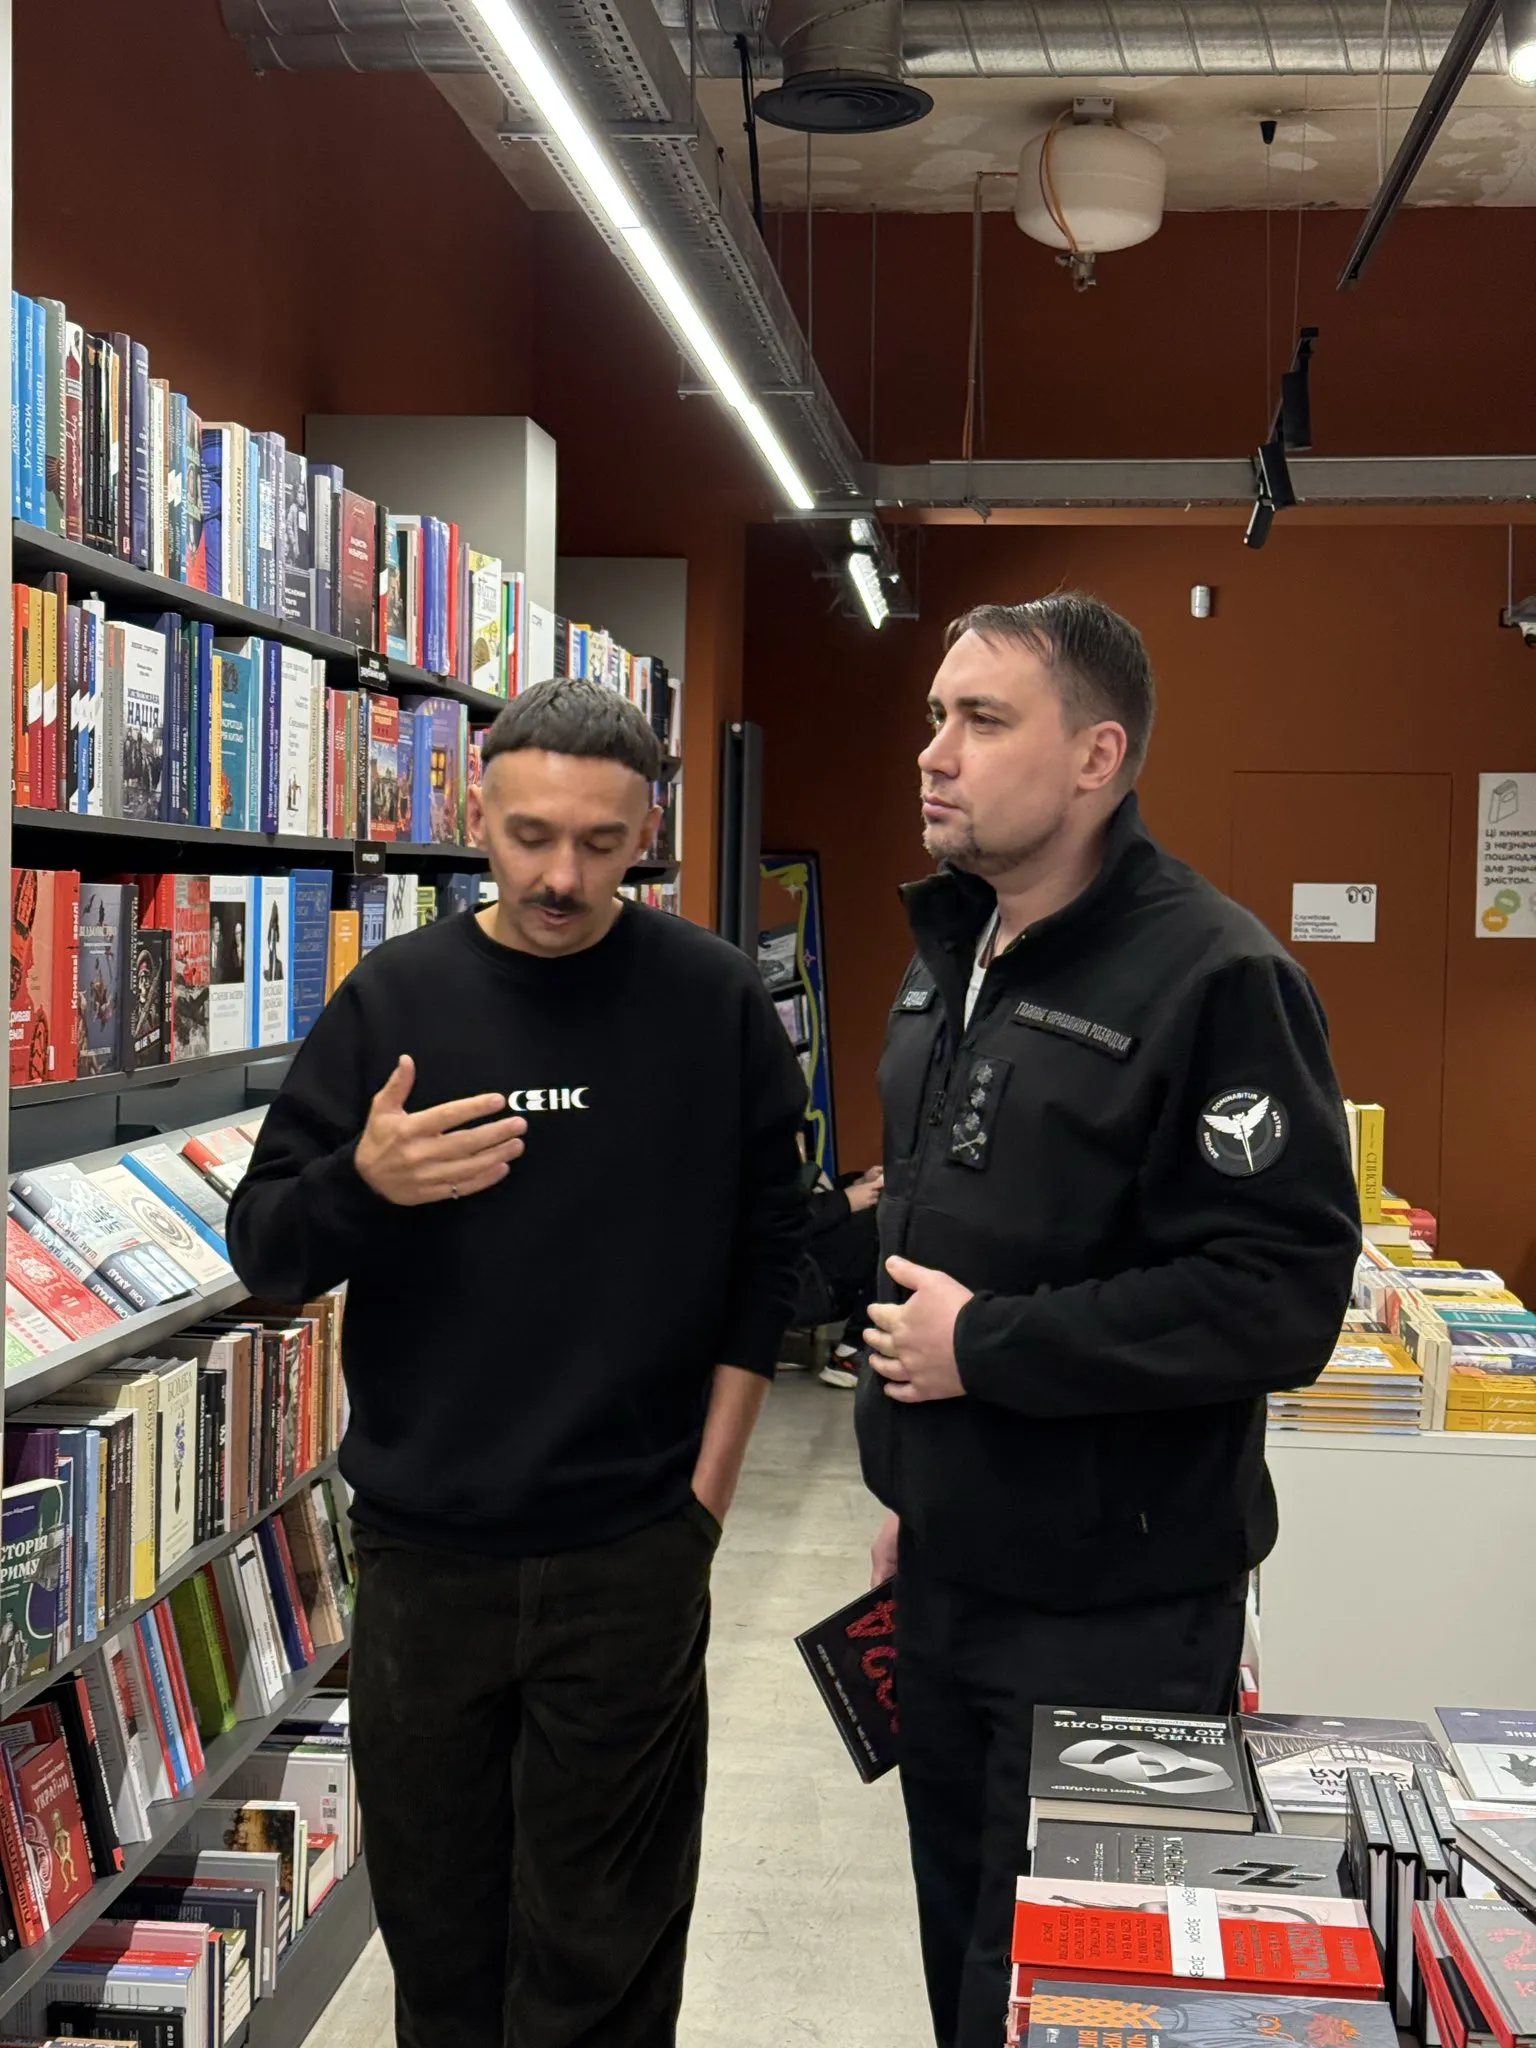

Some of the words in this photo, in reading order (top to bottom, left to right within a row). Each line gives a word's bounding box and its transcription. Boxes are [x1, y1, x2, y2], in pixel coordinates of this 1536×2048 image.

[23, 403, 32, 469] МОССАД
[127, 701, 161, 730] НАЦІЯ
[1485, 829, 1497, 838] Ці
[1484, 865, 1504, 873] але
[71, 901, 80, 940] землі
[70, 954, 79, 1009] Криваві
[1091, 1022, 1132, 1051] РОЗВІДКИ
[1211, 1092, 1259, 1112] DOMINABITUR
[1270, 1110, 1282, 1138] ASTRIS
[79, 1241, 98, 1260] ШАЛЕ
[63, 1256, 83, 1276] ШАЛЕ
[106, 1268, 131, 1290] ДЖАДТ
[91, 1283, 117, 1305] ДЖАДТ
[129, 1289, 146, 1308] ТОНІ
[1053, 1720, 1187, 1736] несвободи
[1152, 1732, 1226, 1746] Шлях
[1198, 1727, 1224, 1738] до
[33, 1777, 69, 1812] УКРАЇНИ
[1050, 1784, 1108, 1794] СНАЙДЕР
[1131, 1834, 1155, 1886] НАЦІОНАЛ
[1162, 1836, 1188, 1887] УКРАЇНСЬК
[1186, 1917, 1202, 1944] Зразок
[1286, 1925, 1331, 1981] СЕСТРА
